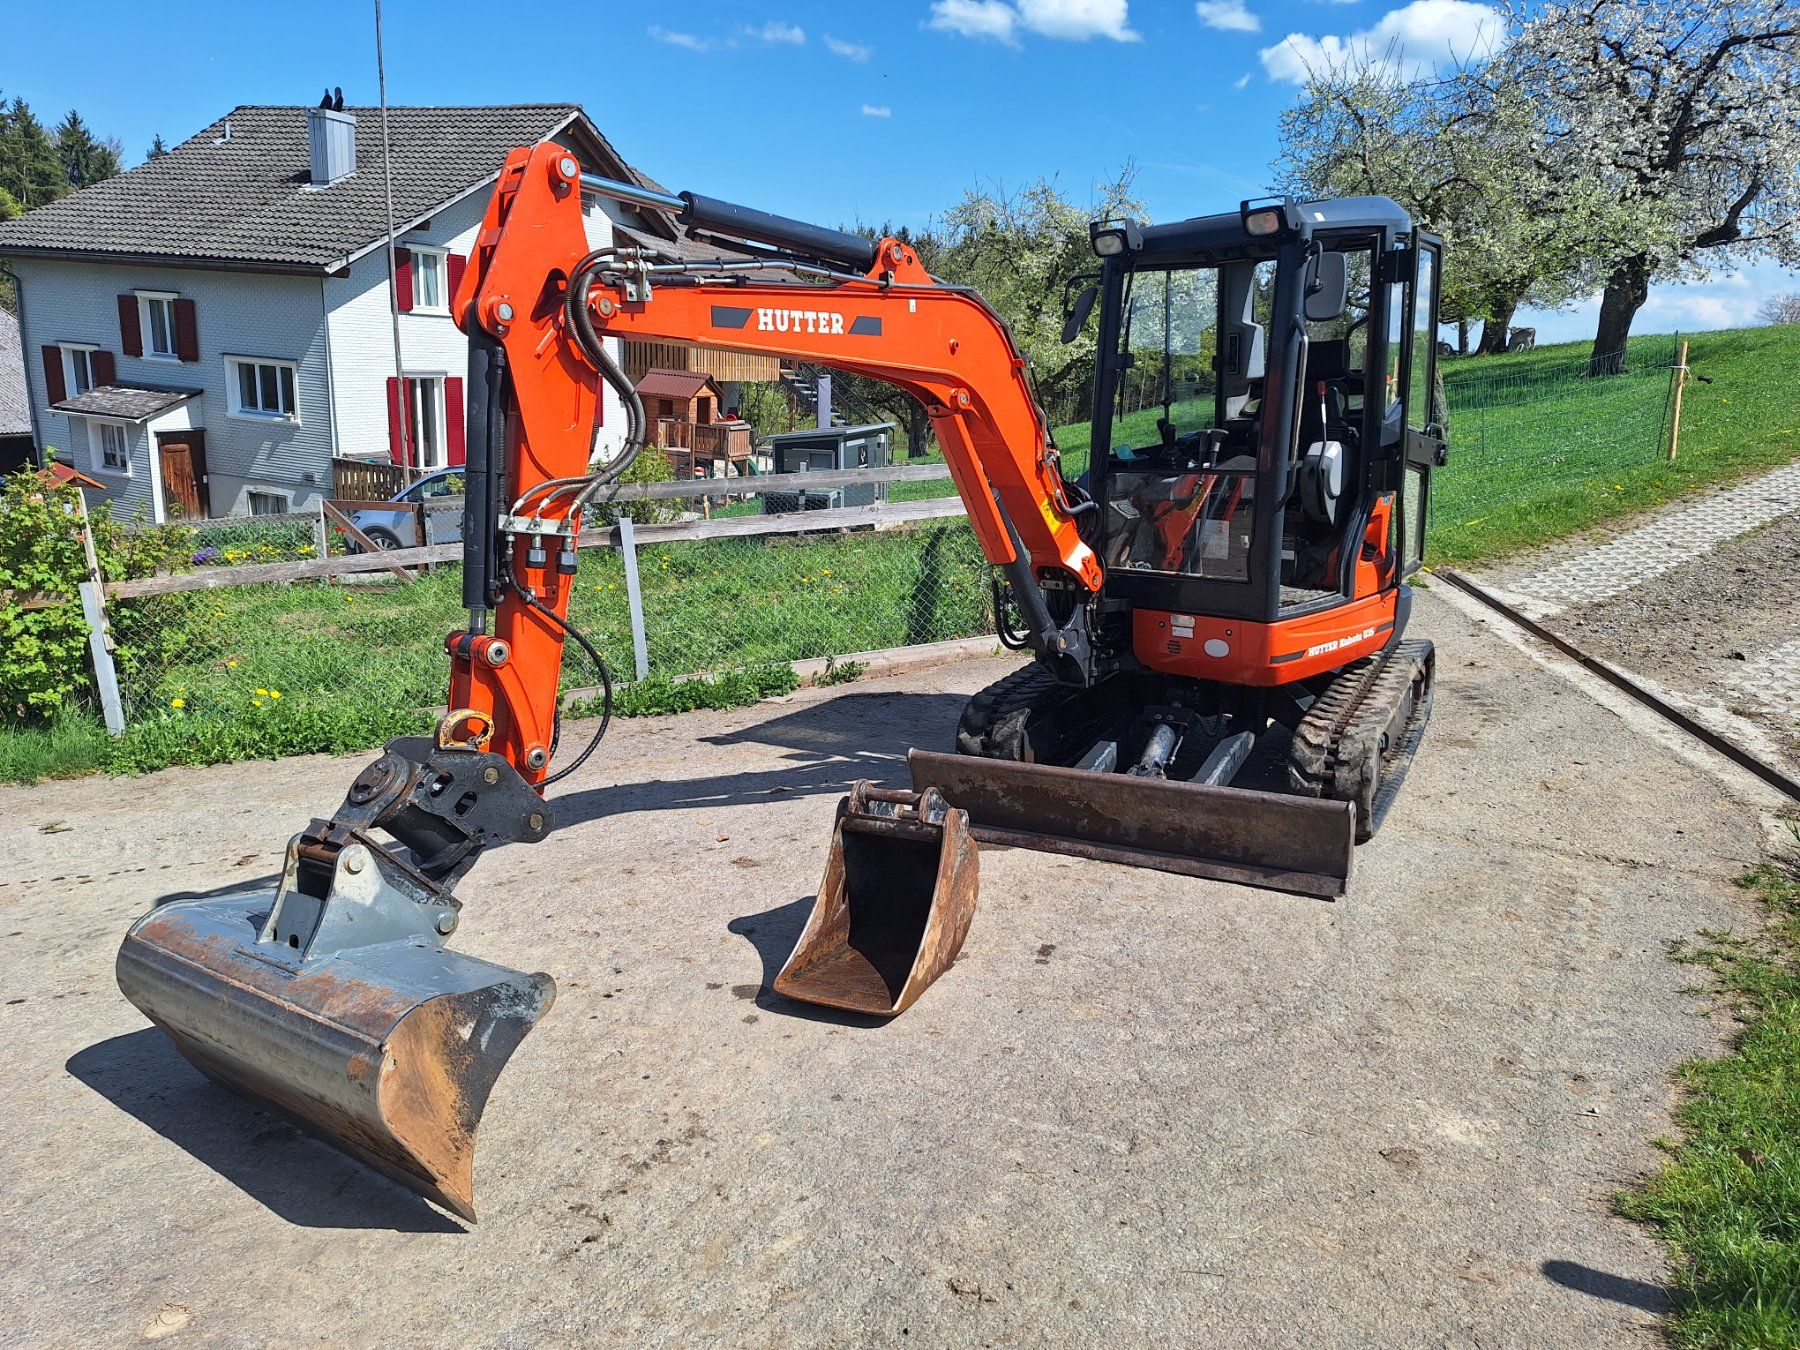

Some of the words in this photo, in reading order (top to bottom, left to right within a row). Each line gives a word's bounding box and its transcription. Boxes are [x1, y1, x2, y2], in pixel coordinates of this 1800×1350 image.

[757, 308, 844, 335] HUTTER
[1308, 640, 1339, 657] HUTTER
[1339, 633, 1363, 648] Kubota
